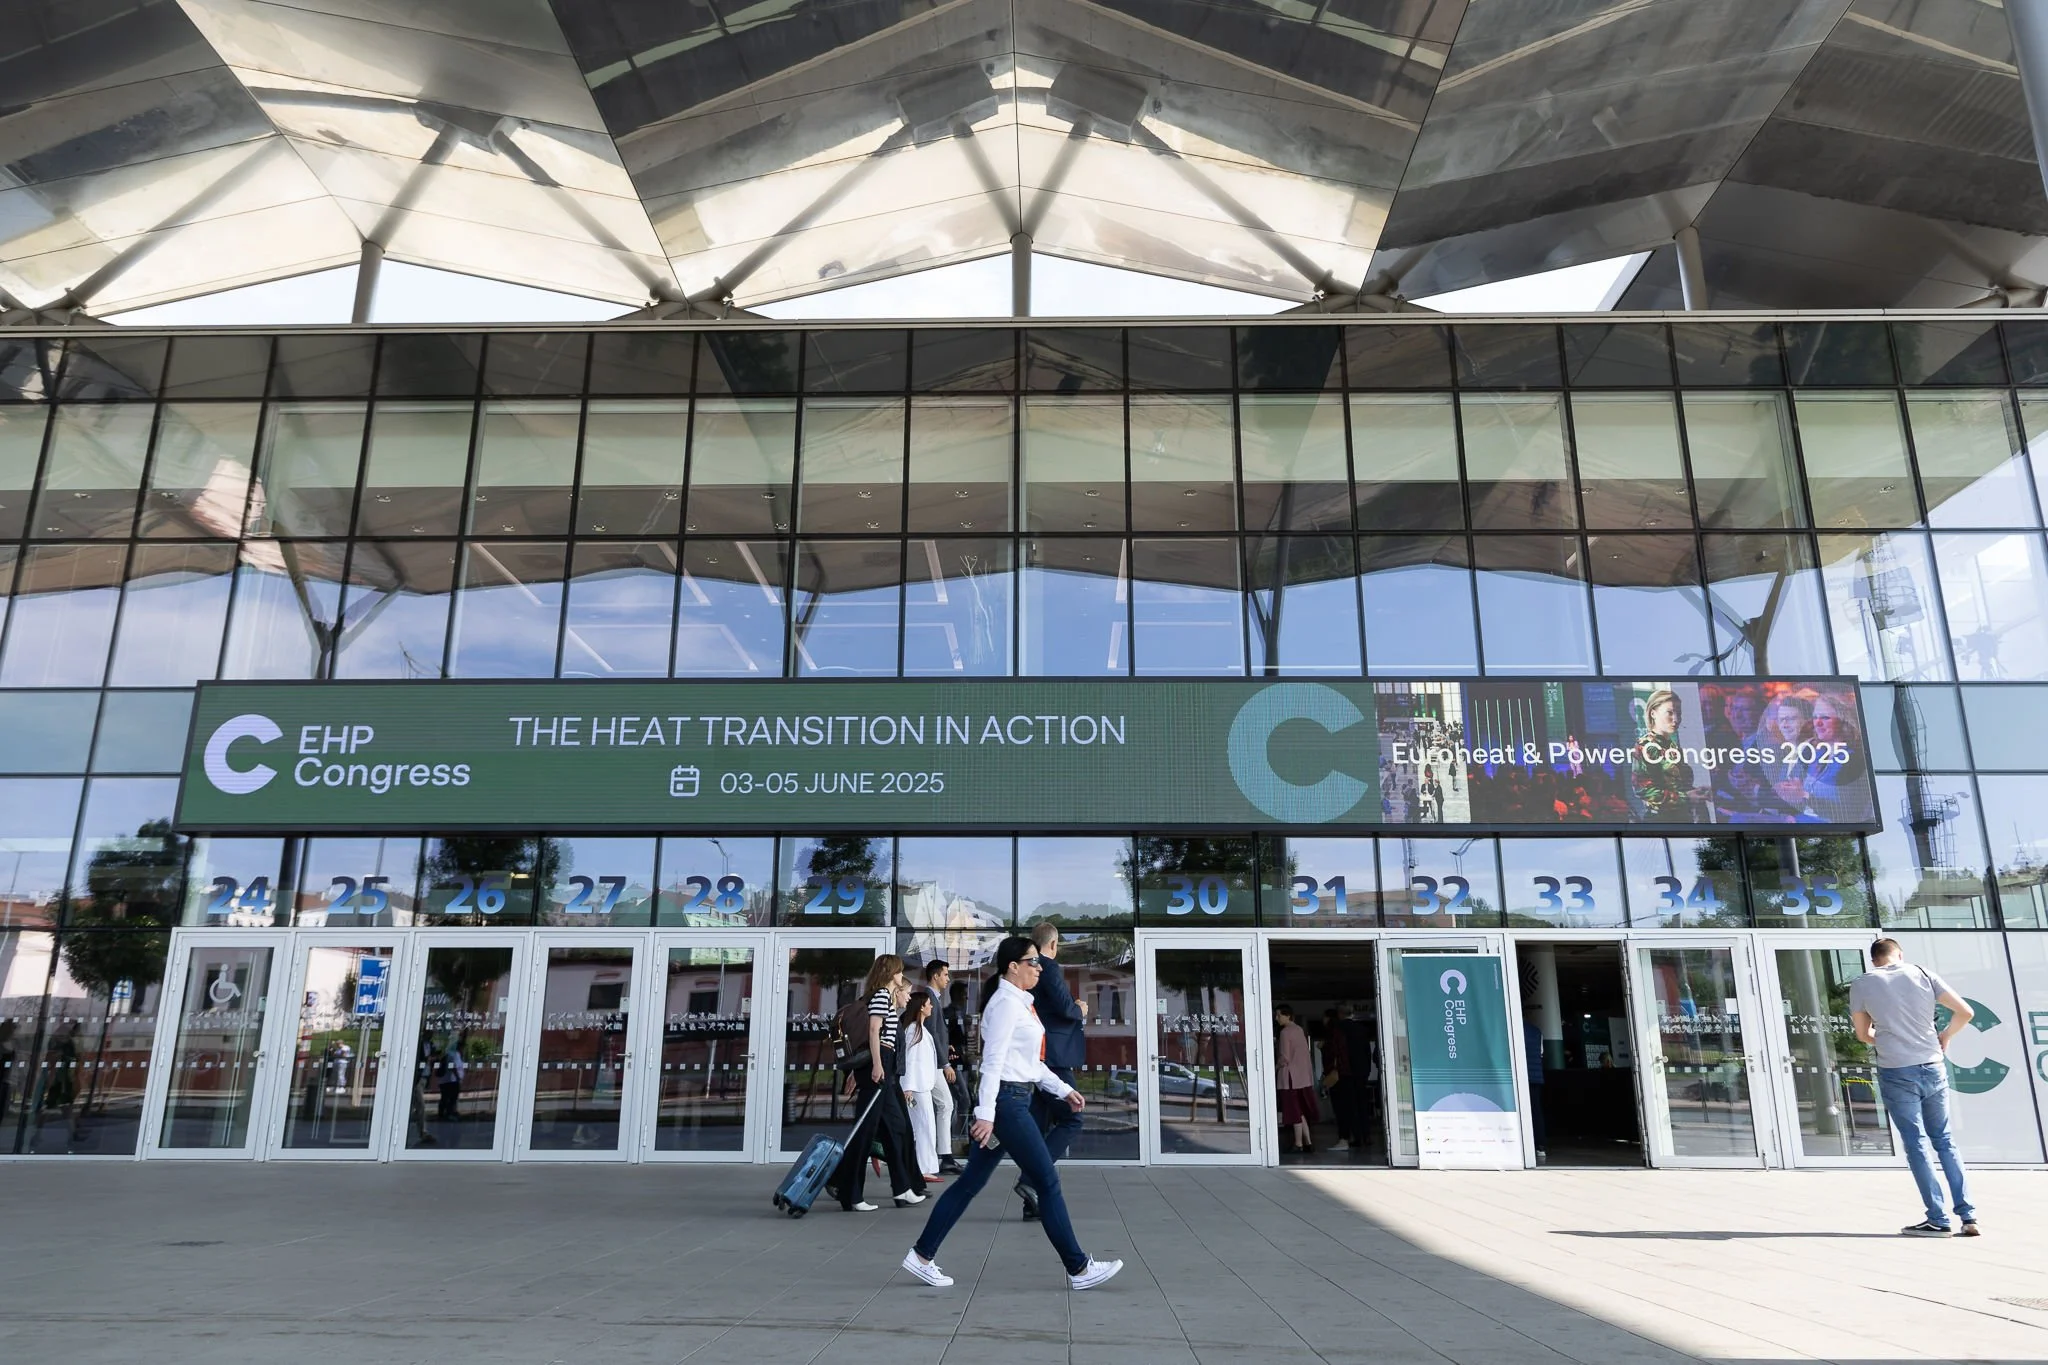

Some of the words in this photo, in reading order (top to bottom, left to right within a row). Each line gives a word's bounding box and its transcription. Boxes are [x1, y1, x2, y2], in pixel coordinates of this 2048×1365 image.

[298, 725, 375, 754] EHP
[508, 716, 582, 746] THE
[590, 716, 692, 746] HEAT
[699, 715, 925, 746] TRANSITION
[935, 715, 970, 745] IN
[978, 715, 1126, 745] ACTION
[293, 756, 471, 794] Congress
[1391, 741, 1517, 765] Euroheat
[1522, 742, 1543, 765] &
[1548, 741, 1636, 765] Power
[1640, 741, 1776, 770] Congress
[1780, 741, 1850, 764] 2025
[719, 772, 799, 794] 03-05
[804, 772, 875, 794] JUNE
[879, 771, 945, 793] 2025
[207, 875, 270, 915] 24
[328, 875, 389, 915] 25
[444, 875, 506, 915] 26
[564, 875, 627, 915] 27
[682, 875, 746, 915] 28
[804, 875, 866, 915] 29
[1166, 875, 1229, 915] 30
[1291, 875, 1348, 915] 31
[1411, 875, 1473, 915] 32
[1533, 875, 1596, 915] 33
[1655, 875, 1721, 915] 34
[1780, 875, 1844, 915] 35
[1443, 999, 1457, 1060] Congress
[1455, 1000, 1467, 1025] EHP
